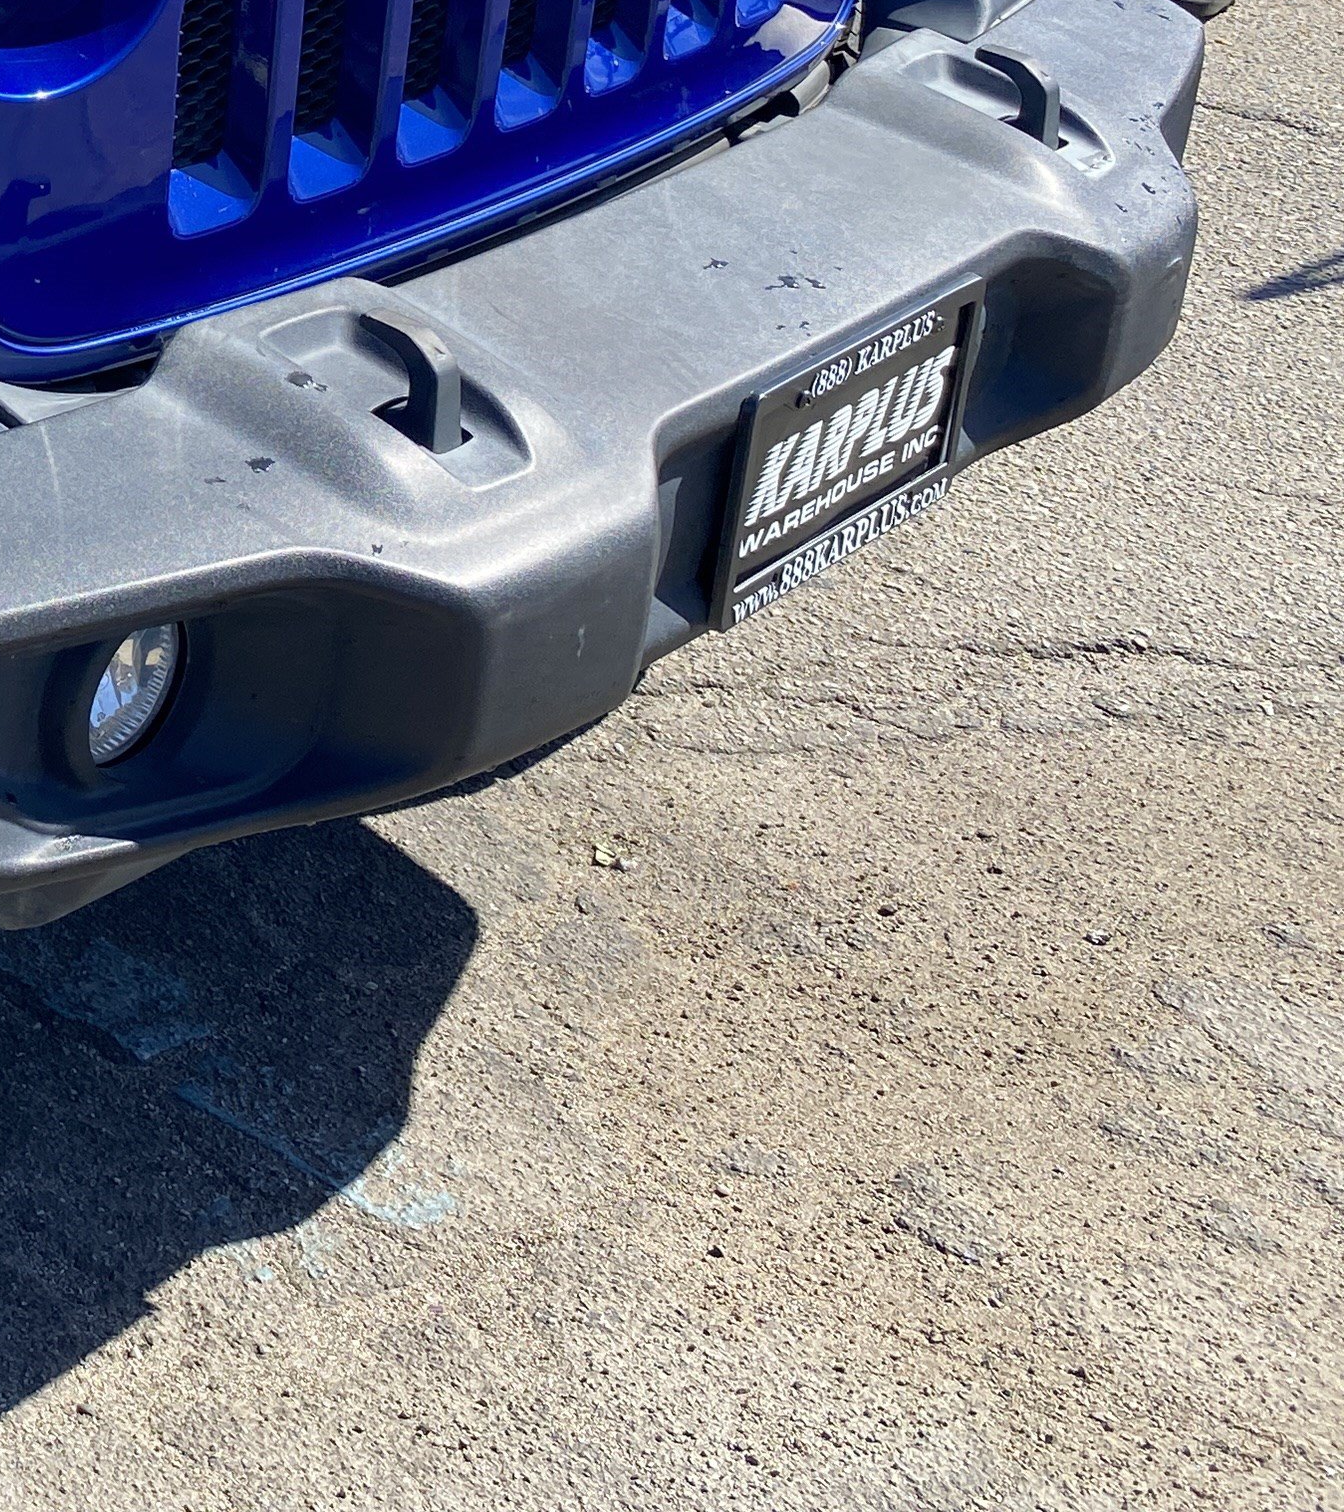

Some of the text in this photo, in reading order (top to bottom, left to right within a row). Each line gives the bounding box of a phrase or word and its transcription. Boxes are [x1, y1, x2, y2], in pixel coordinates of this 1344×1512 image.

[812, 309, 937, 398] (888) KARPLUS
[744, 345, 956, 527] KARPLUS
[738, 451, 896, 559] WAREHOUSE
